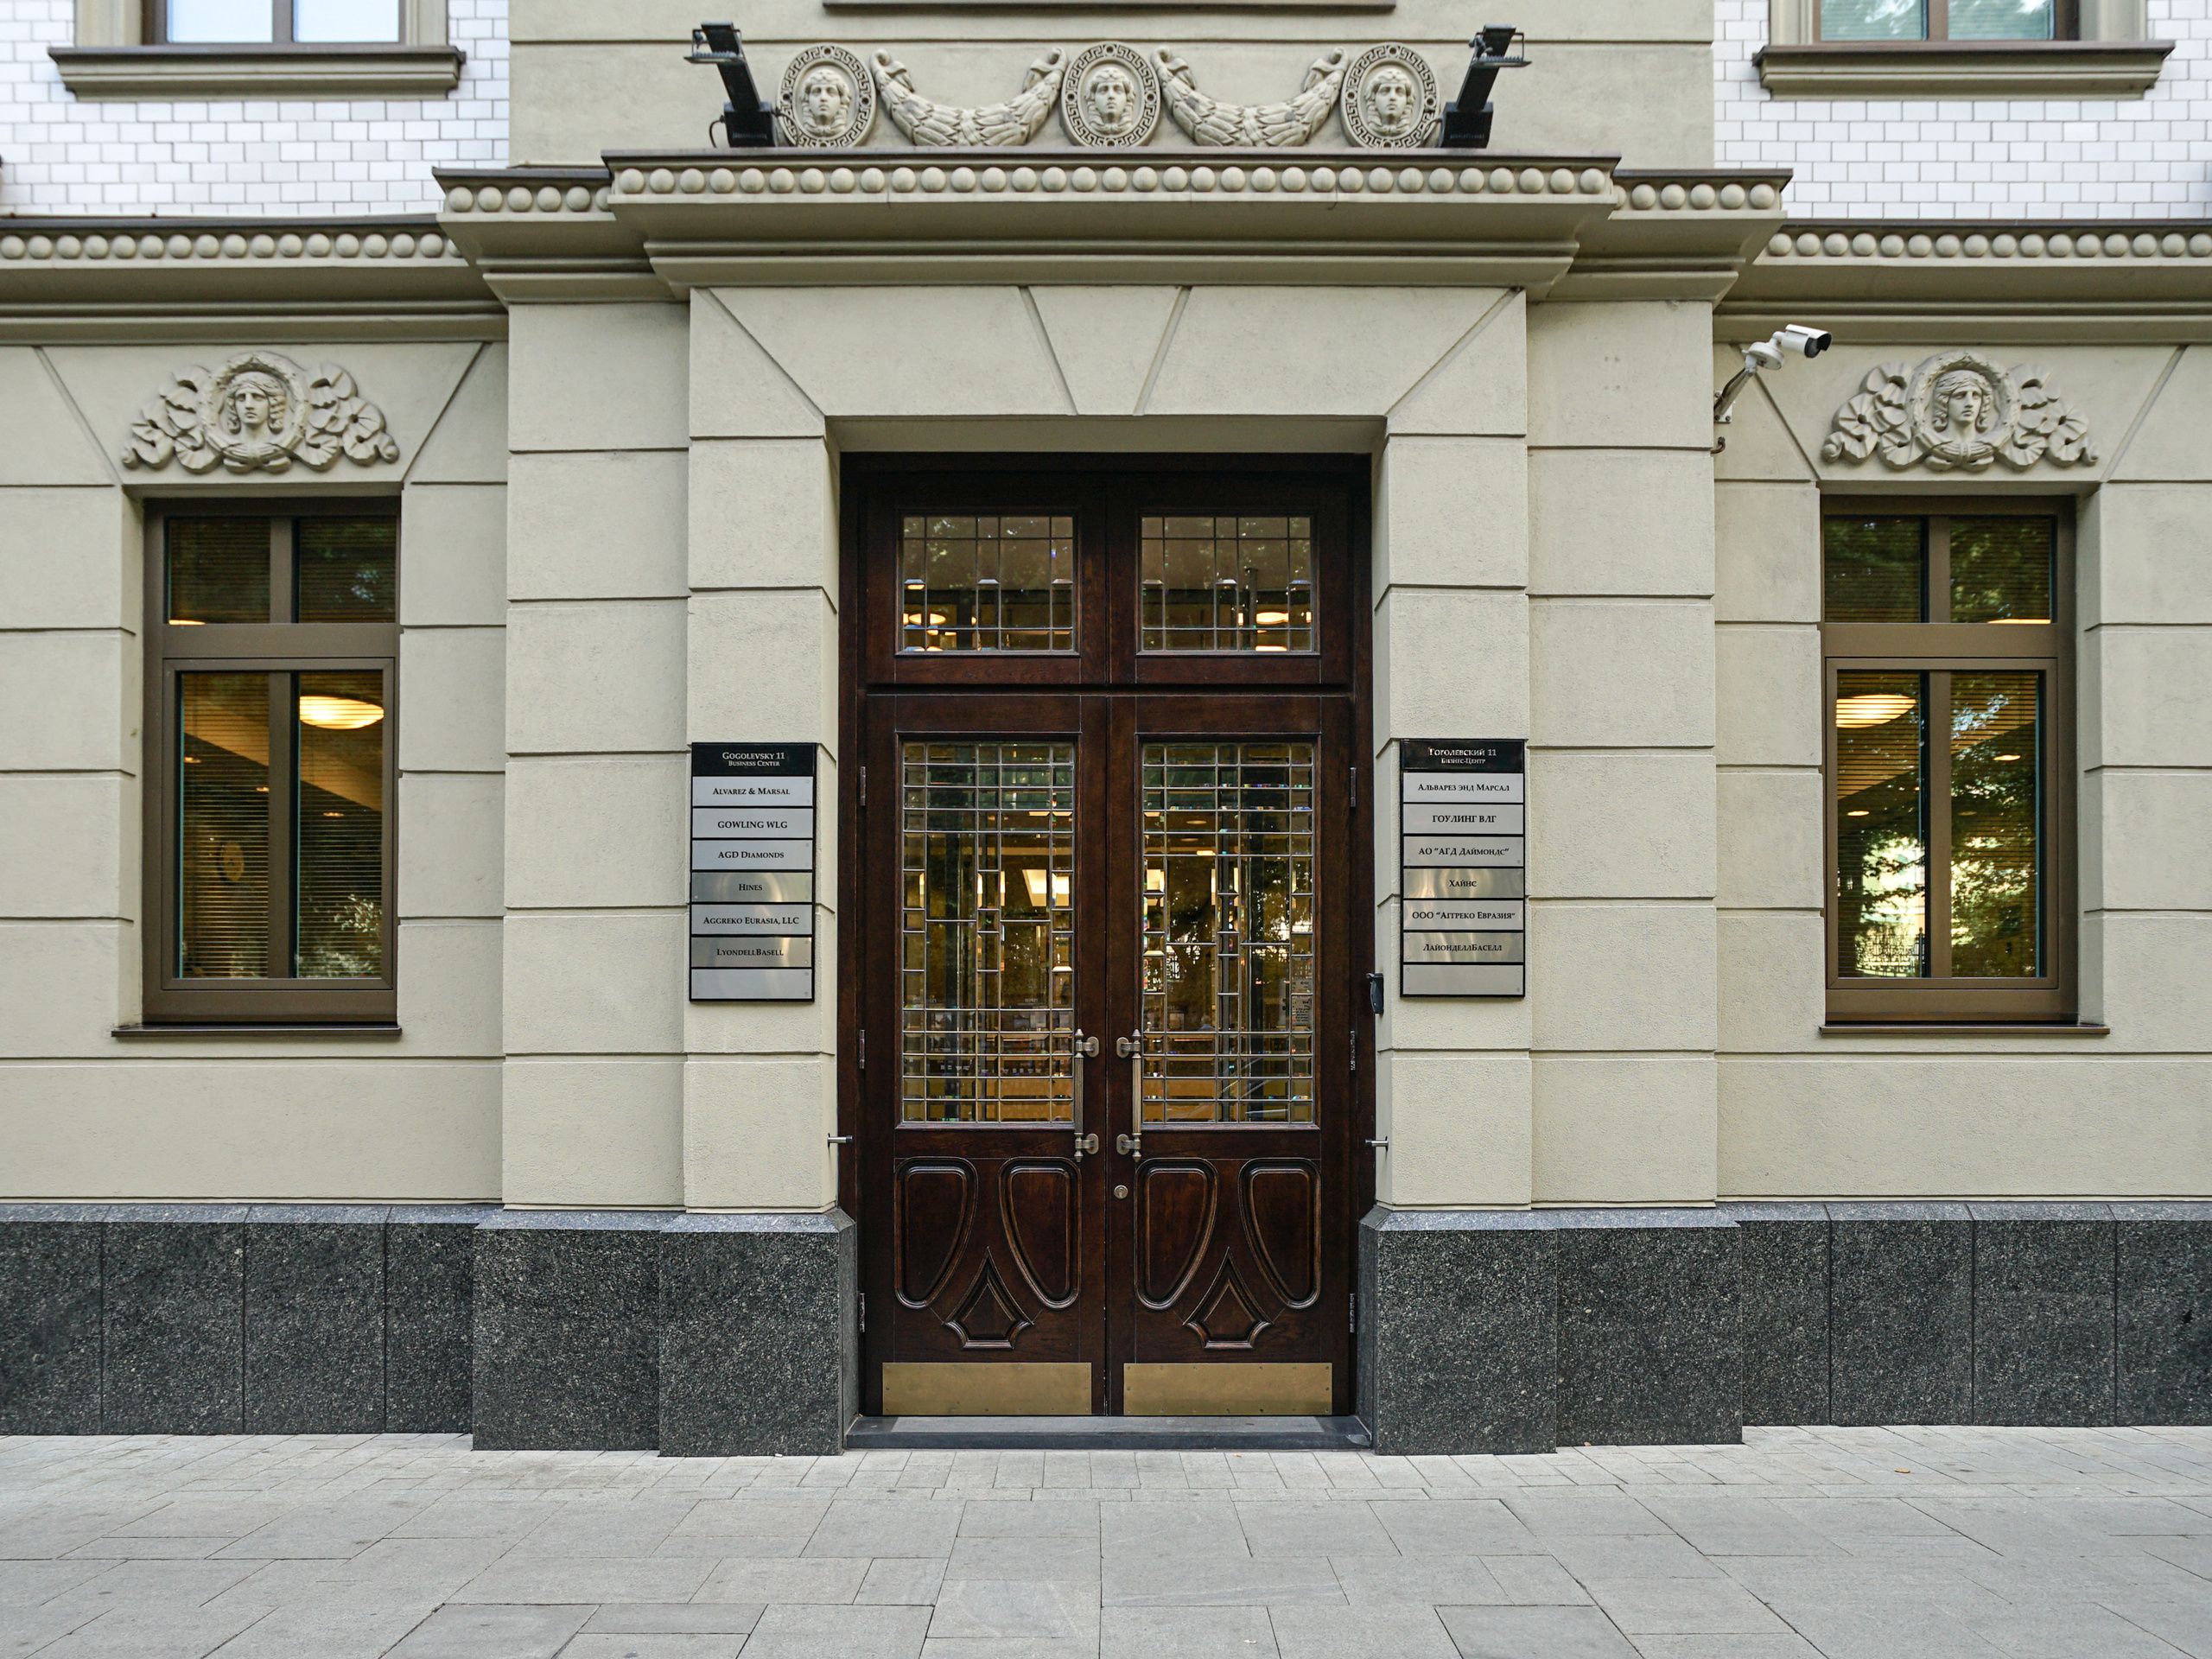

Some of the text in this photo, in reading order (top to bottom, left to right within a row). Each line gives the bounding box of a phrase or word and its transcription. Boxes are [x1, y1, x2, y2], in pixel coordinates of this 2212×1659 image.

[721, 752, 775, 760] GOGOLEVSKY
[744, 917, 781, 925] EURASIA,
[1422, 944, 1503, 952] ЛАЙОНДЕЛЛБАСЕЛЛ
